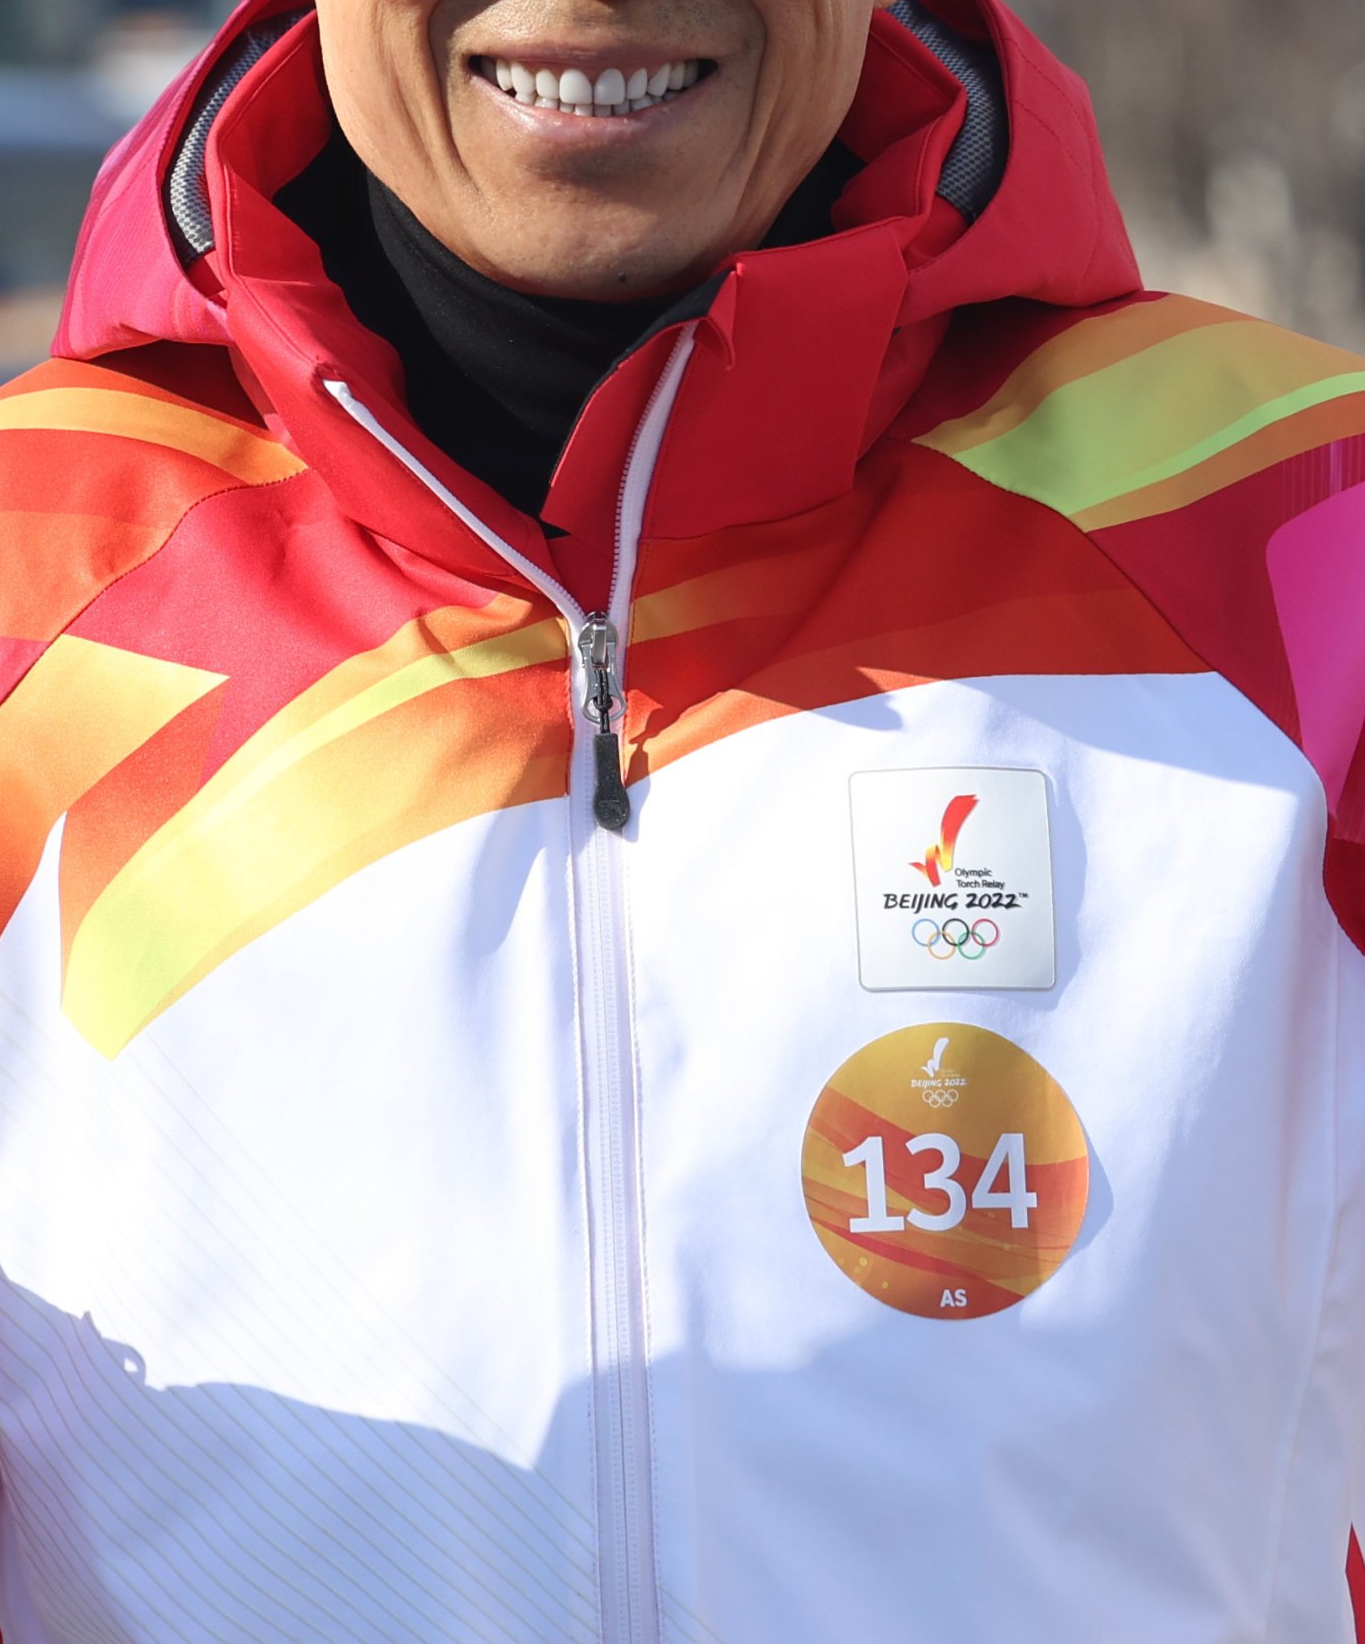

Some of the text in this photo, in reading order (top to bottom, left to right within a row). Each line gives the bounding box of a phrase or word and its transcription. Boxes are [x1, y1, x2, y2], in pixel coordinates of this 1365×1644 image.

[954, 867, 992, 878] Olympic
[956, 879, 1005, 890] Torch Relay
[883, 893, 958, 914] BEIJING
[842, 1132, 1038, 1234] 134
[940, 1289, 968, 1307] AS
